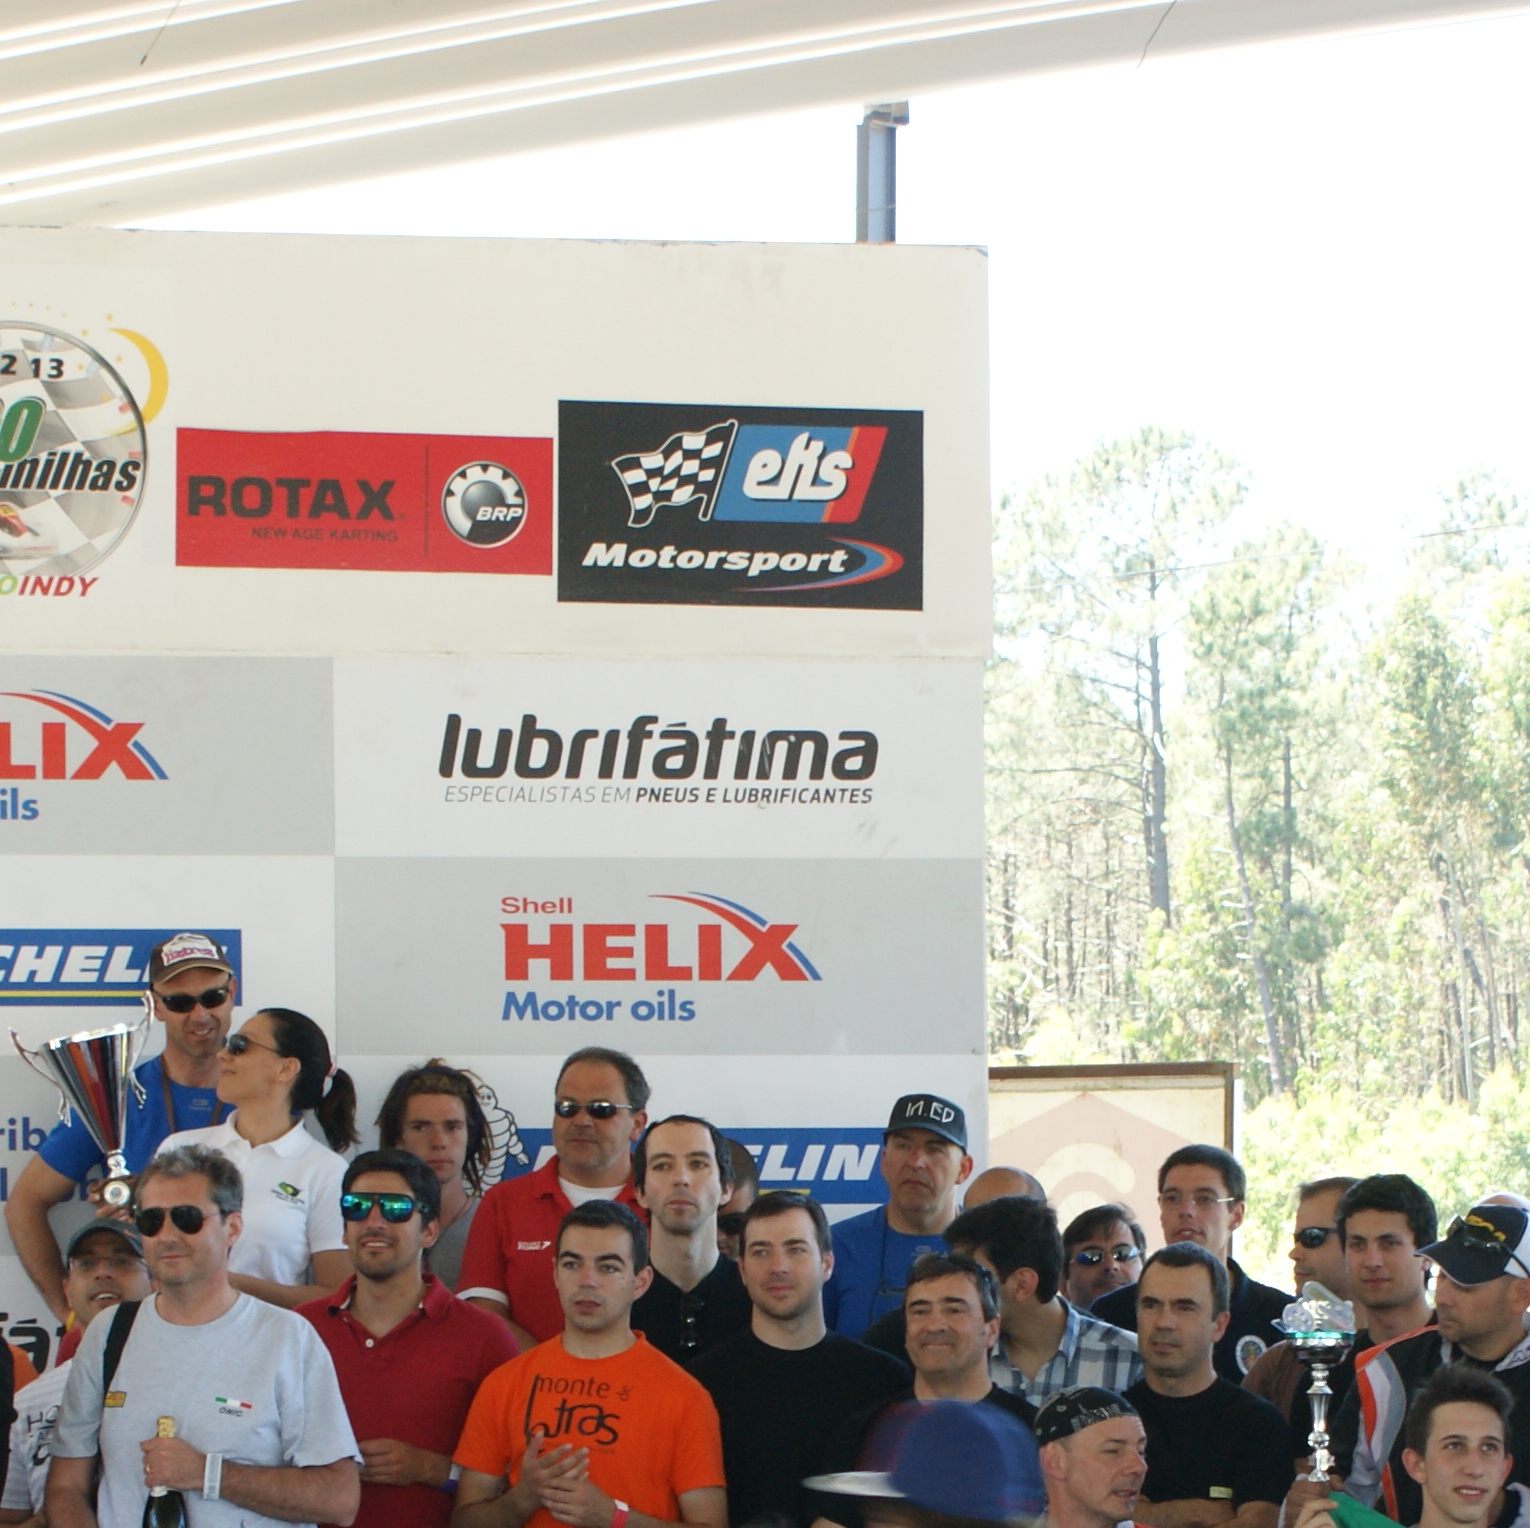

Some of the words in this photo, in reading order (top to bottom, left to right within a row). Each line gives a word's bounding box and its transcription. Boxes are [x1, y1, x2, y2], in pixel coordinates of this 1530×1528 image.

[31, 358, 64, 378] 13
[187, 476, 395, 521] ROTAX
[475, 506, 523, 522] BRP
[252, 527, 285, 539] NEW
[292, 528, 322, 540] AGE
[329, 530, 397, 542] KARTING
[582, 542, 848, 577] Motorsport
[438, 713, 879, 780] lubrifátima
[444, 785, 596, 803] ESPECIALISTAS
[601, 787, 631, 803] EM
[635, 787, 699, 803] PNEUS
[705, 787, 717, 803] E
[722, 787, 873, 804] LUBRIFICANTES
[500, 896, 573, 914] Shell
[500, 924, 808, 981] HELIX
[502, 992, 620, 1022] Motor
[631, 990, 696, 1022] oils
